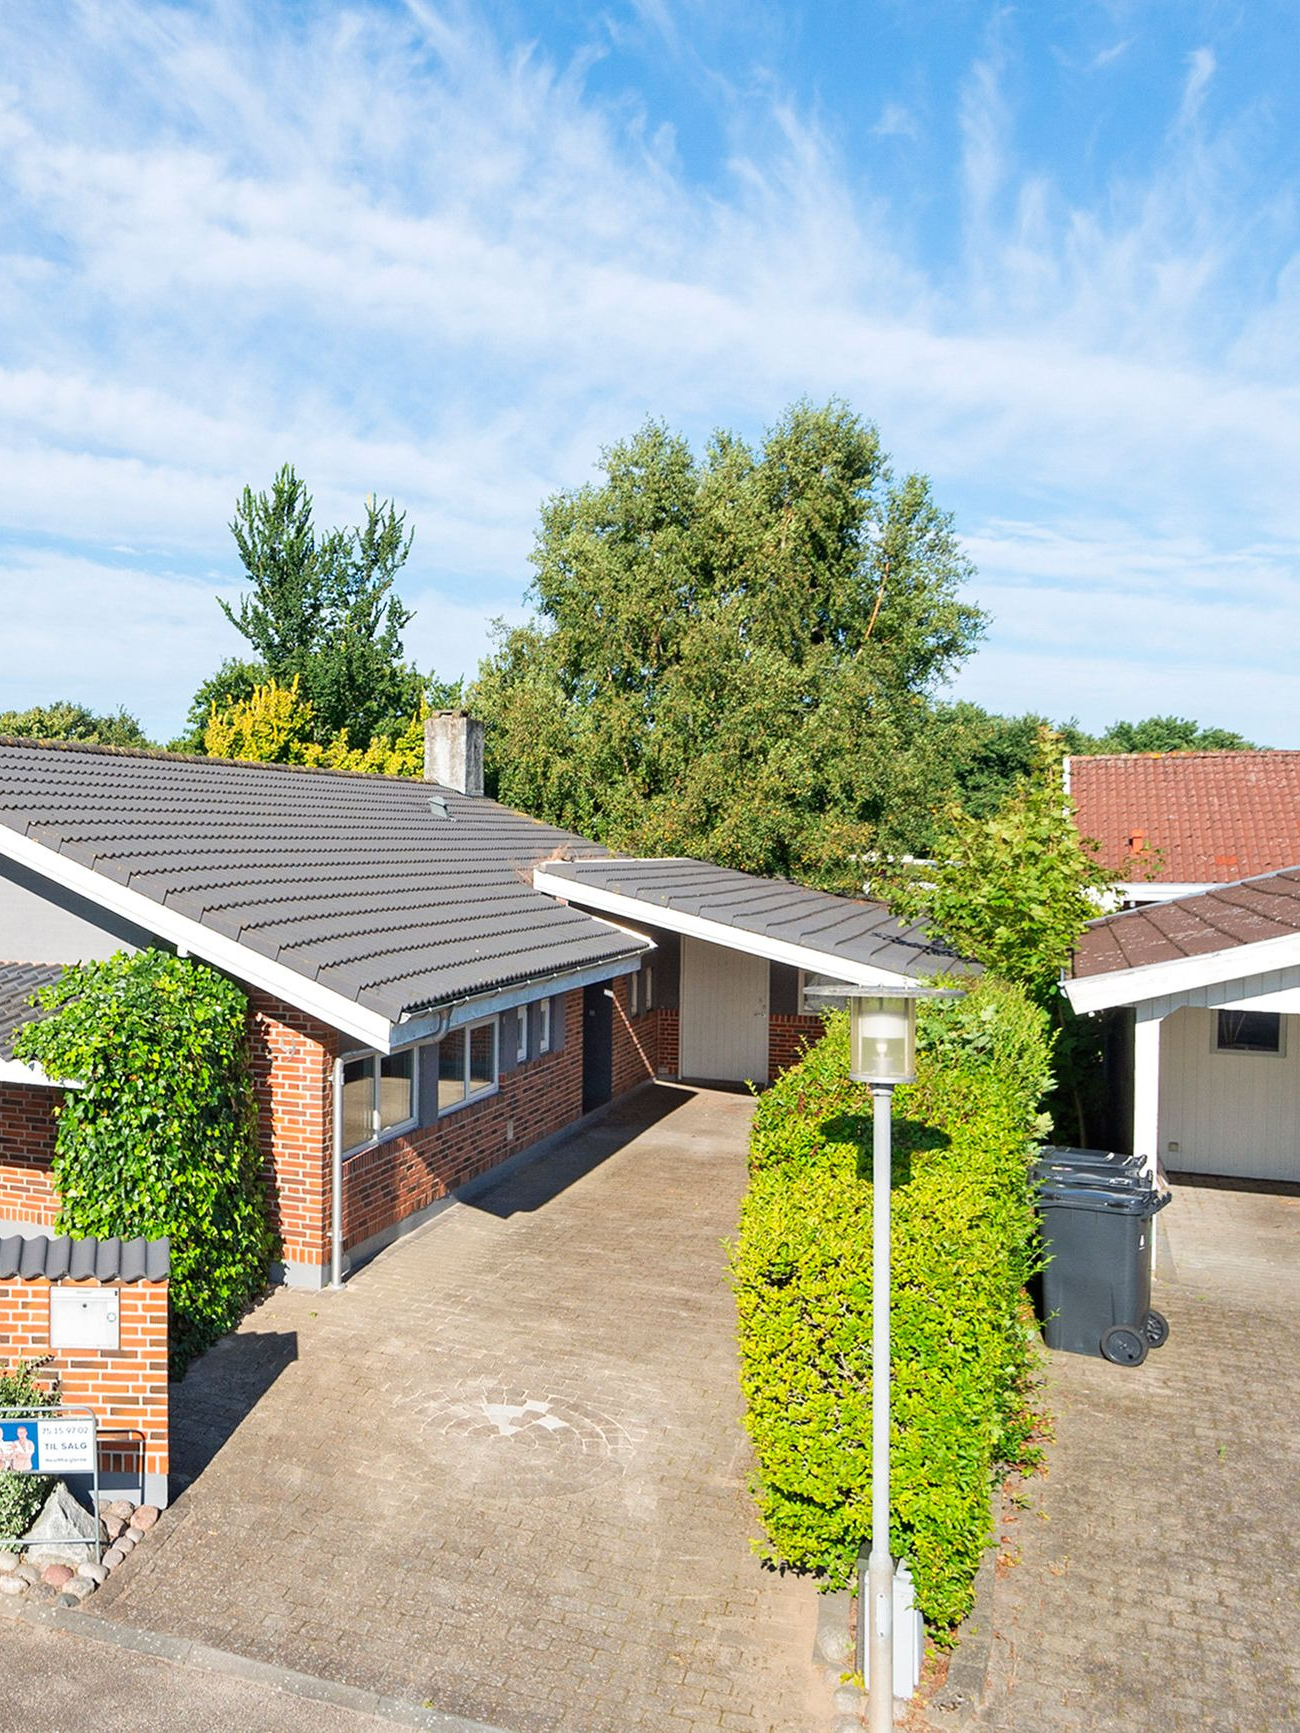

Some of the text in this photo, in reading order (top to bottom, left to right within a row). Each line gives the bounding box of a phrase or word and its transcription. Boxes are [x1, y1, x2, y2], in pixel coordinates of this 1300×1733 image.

[42, 1427, 51, 1435] 75
[54, 1427, 63, 1435] 15
[66, 1427, 76, 1435] 97
[61, 1442, 88, 1450] SALG
